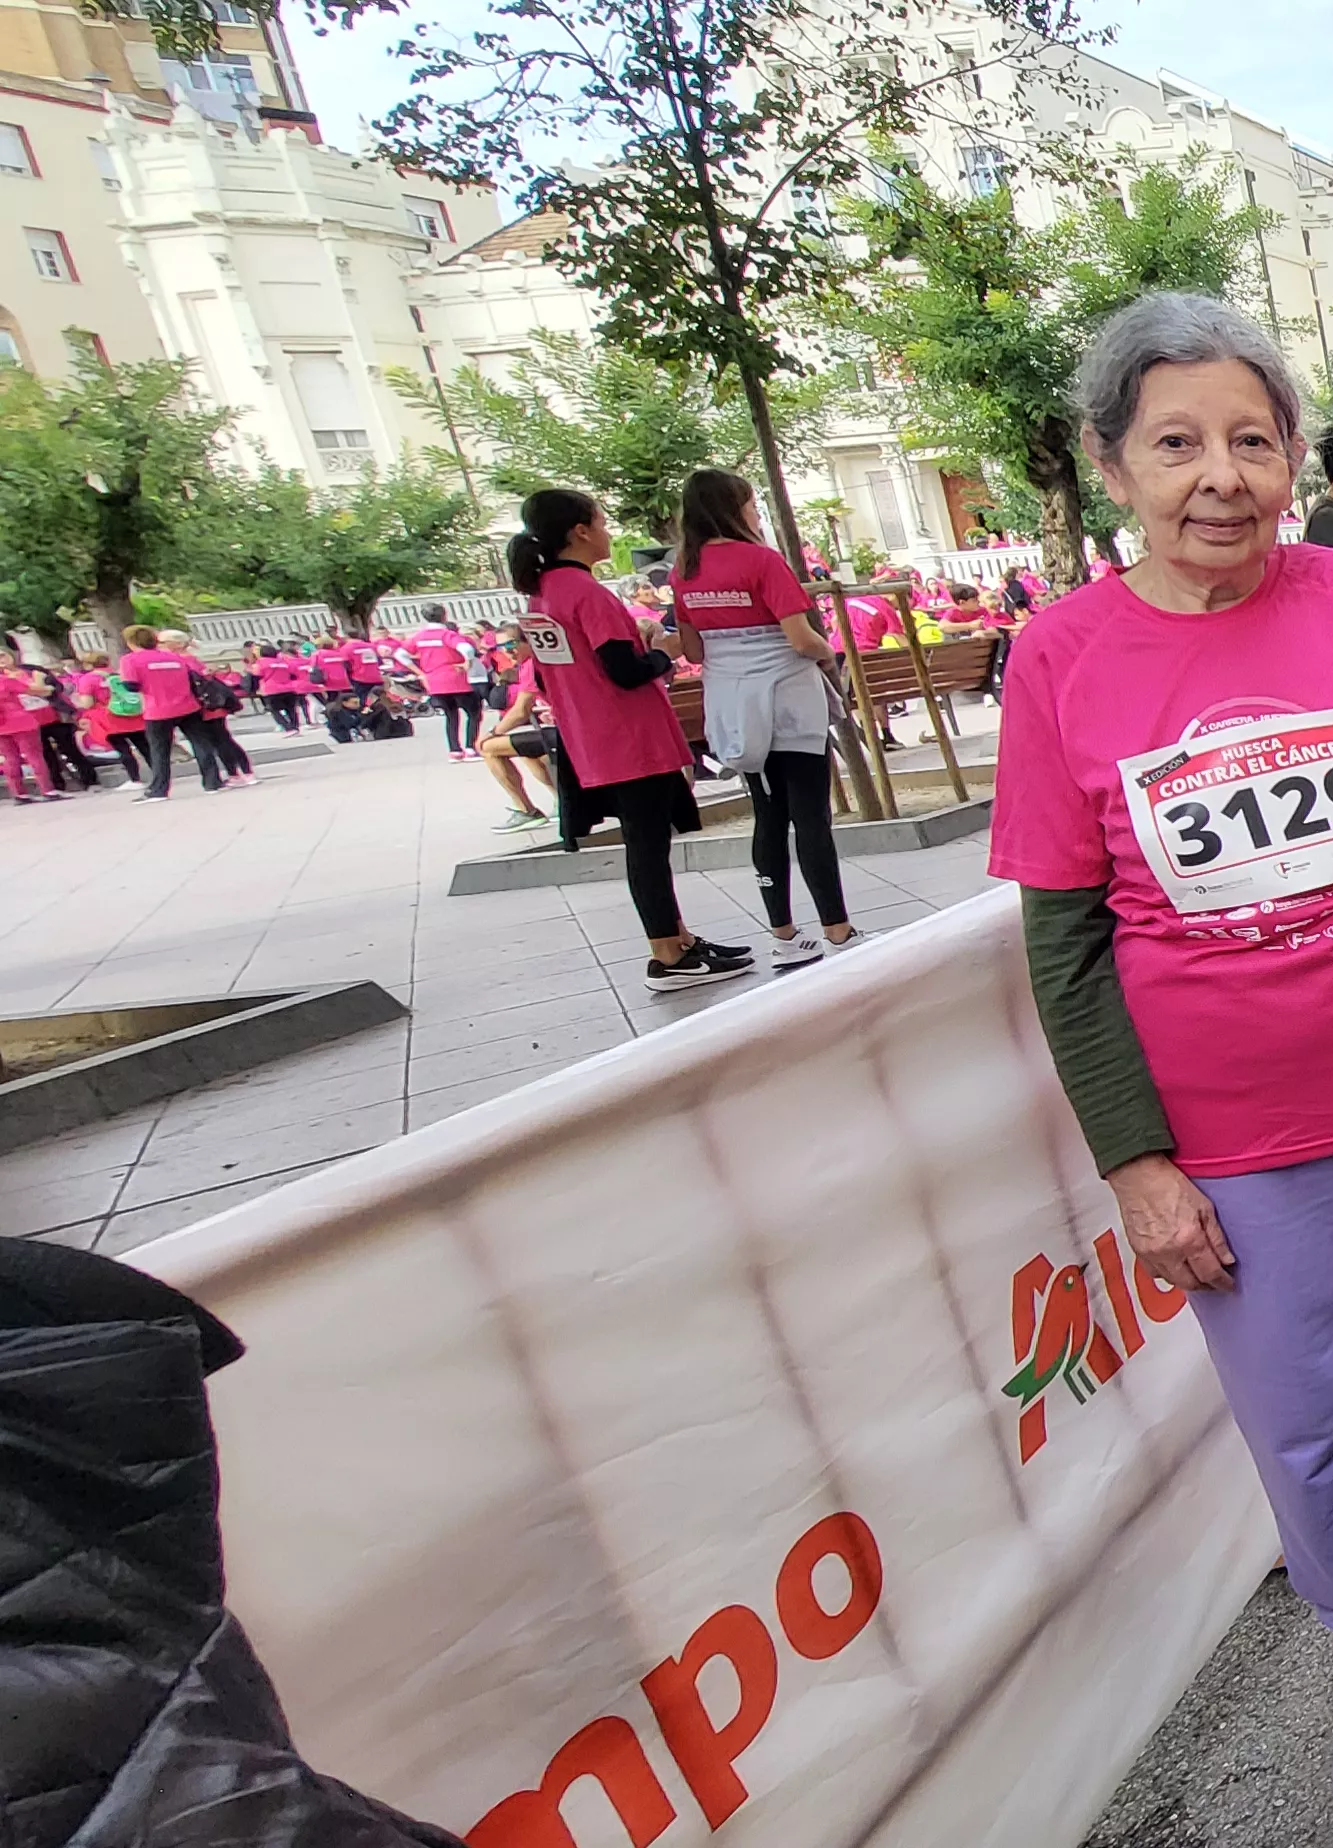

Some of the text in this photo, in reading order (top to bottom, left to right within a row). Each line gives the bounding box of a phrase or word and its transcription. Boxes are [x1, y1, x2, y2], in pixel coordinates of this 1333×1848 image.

[530, 630, 559, 649] 39
[1220, 737, 1284, 763] HUESCA
[1142, 755, 1185, 786] X EDICIÓN
[1158, 763, 1246, 799] CONTRA
[1249, 756, 1274, 775] EL
